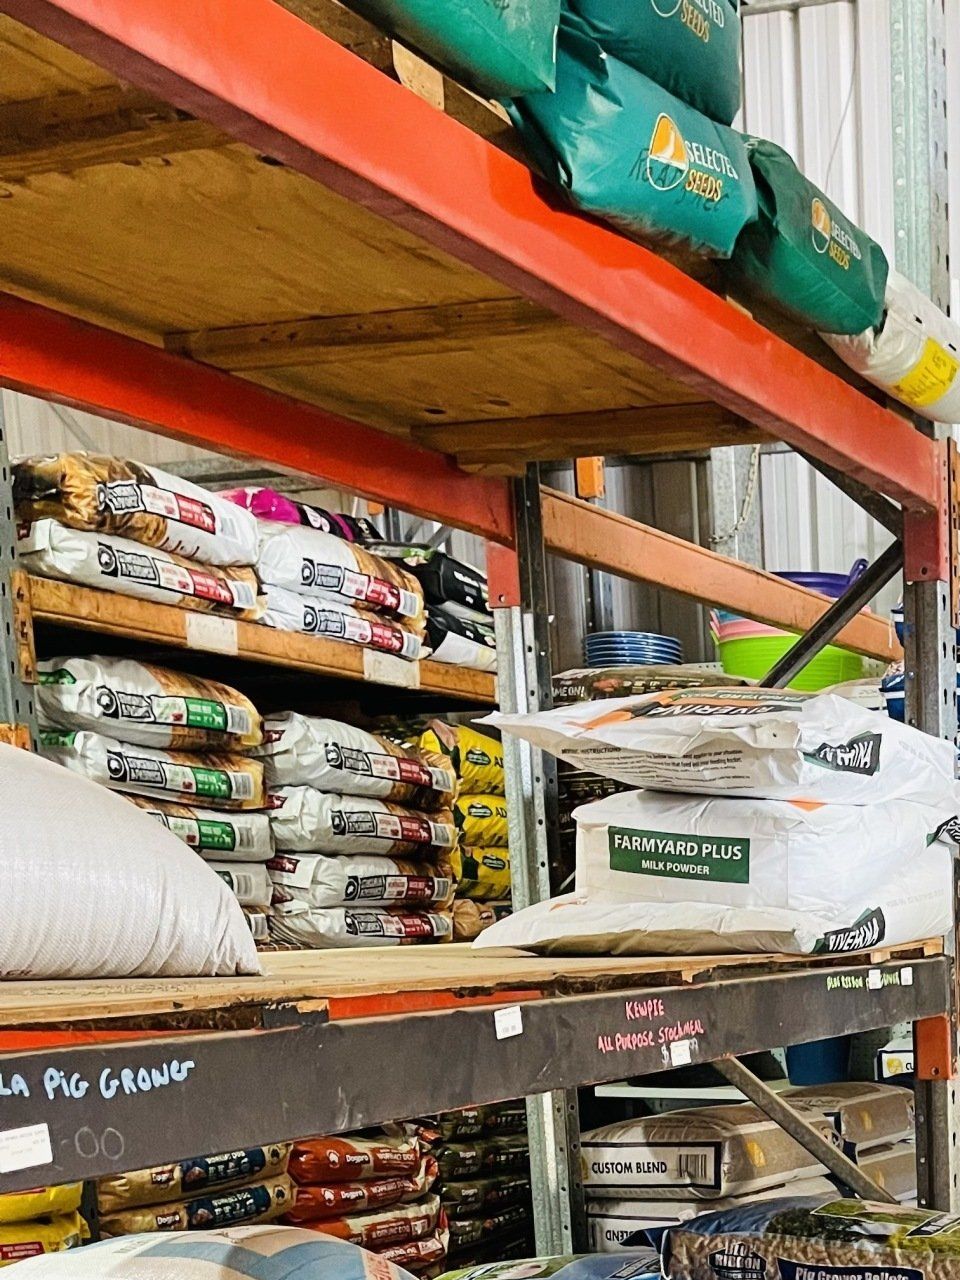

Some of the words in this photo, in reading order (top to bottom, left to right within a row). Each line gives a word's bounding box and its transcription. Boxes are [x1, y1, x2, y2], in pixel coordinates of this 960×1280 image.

[681, 1, 709, 42] SEEDS
[686, 169, 722, 201] SEEDS
[831, 220, 861, 260] SELECTED
[829, 241, 850, 270] SEEDS
[614, 834, 699, 857] FARMYARD
[702, 840, 742, 861] PLUS
[641, 859, 665, 870] MILK
[666, 861, 710, 875] POWDER
[625, 999, 665, 1020] KEWPIE
[598, 1036, 614, 1053] ALL
[346, 1153, 370, 1164] Dogpro
[591, 1162, 633, 1174] CUSTOM
[636, 1161, 667, 1174] BLEND
[341, 1188, 364, 1200] Dogpro
[715, 1254, 761, 1270] RIBBON
